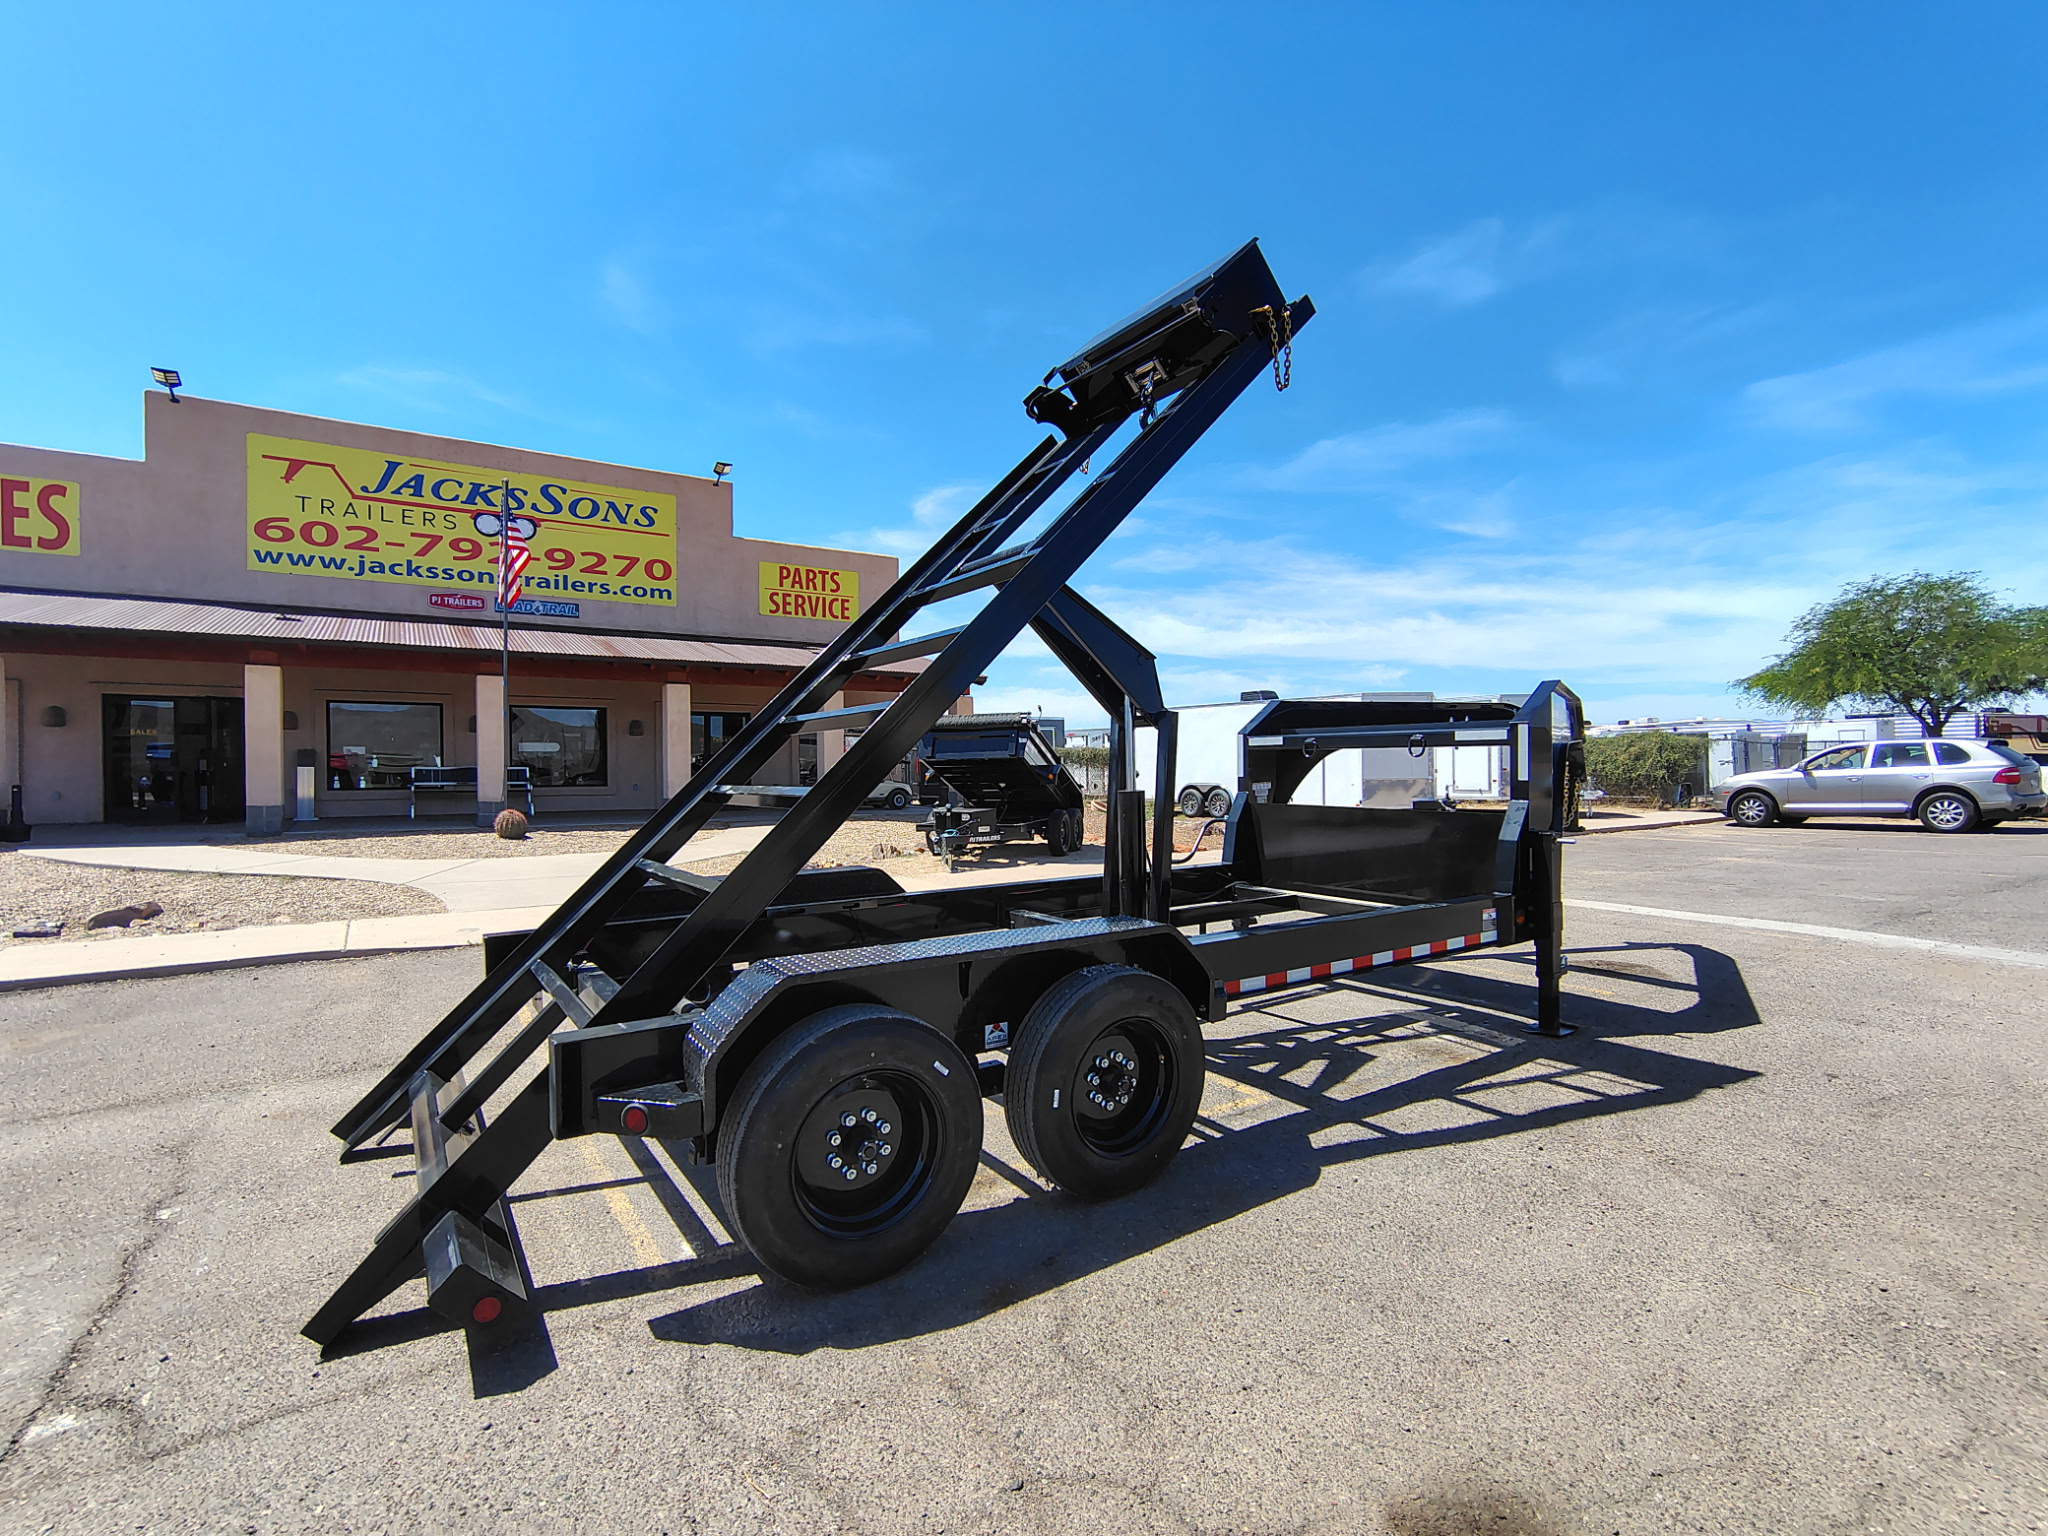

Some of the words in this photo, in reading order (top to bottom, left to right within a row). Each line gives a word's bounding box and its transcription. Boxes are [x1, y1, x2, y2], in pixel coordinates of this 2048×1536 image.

[295, 495, 457, 530] TRAILERS
[253, 549, 672, 600] www.jackssonrailers.com
[779, 565, 841, 593] PARTS
[431, 596, 441, 604] PJ
[444, 596, 483, 607] TRAILERS
[495, 601, 534, 613] LAD
[769, 592, 851, 620] SERVICE
